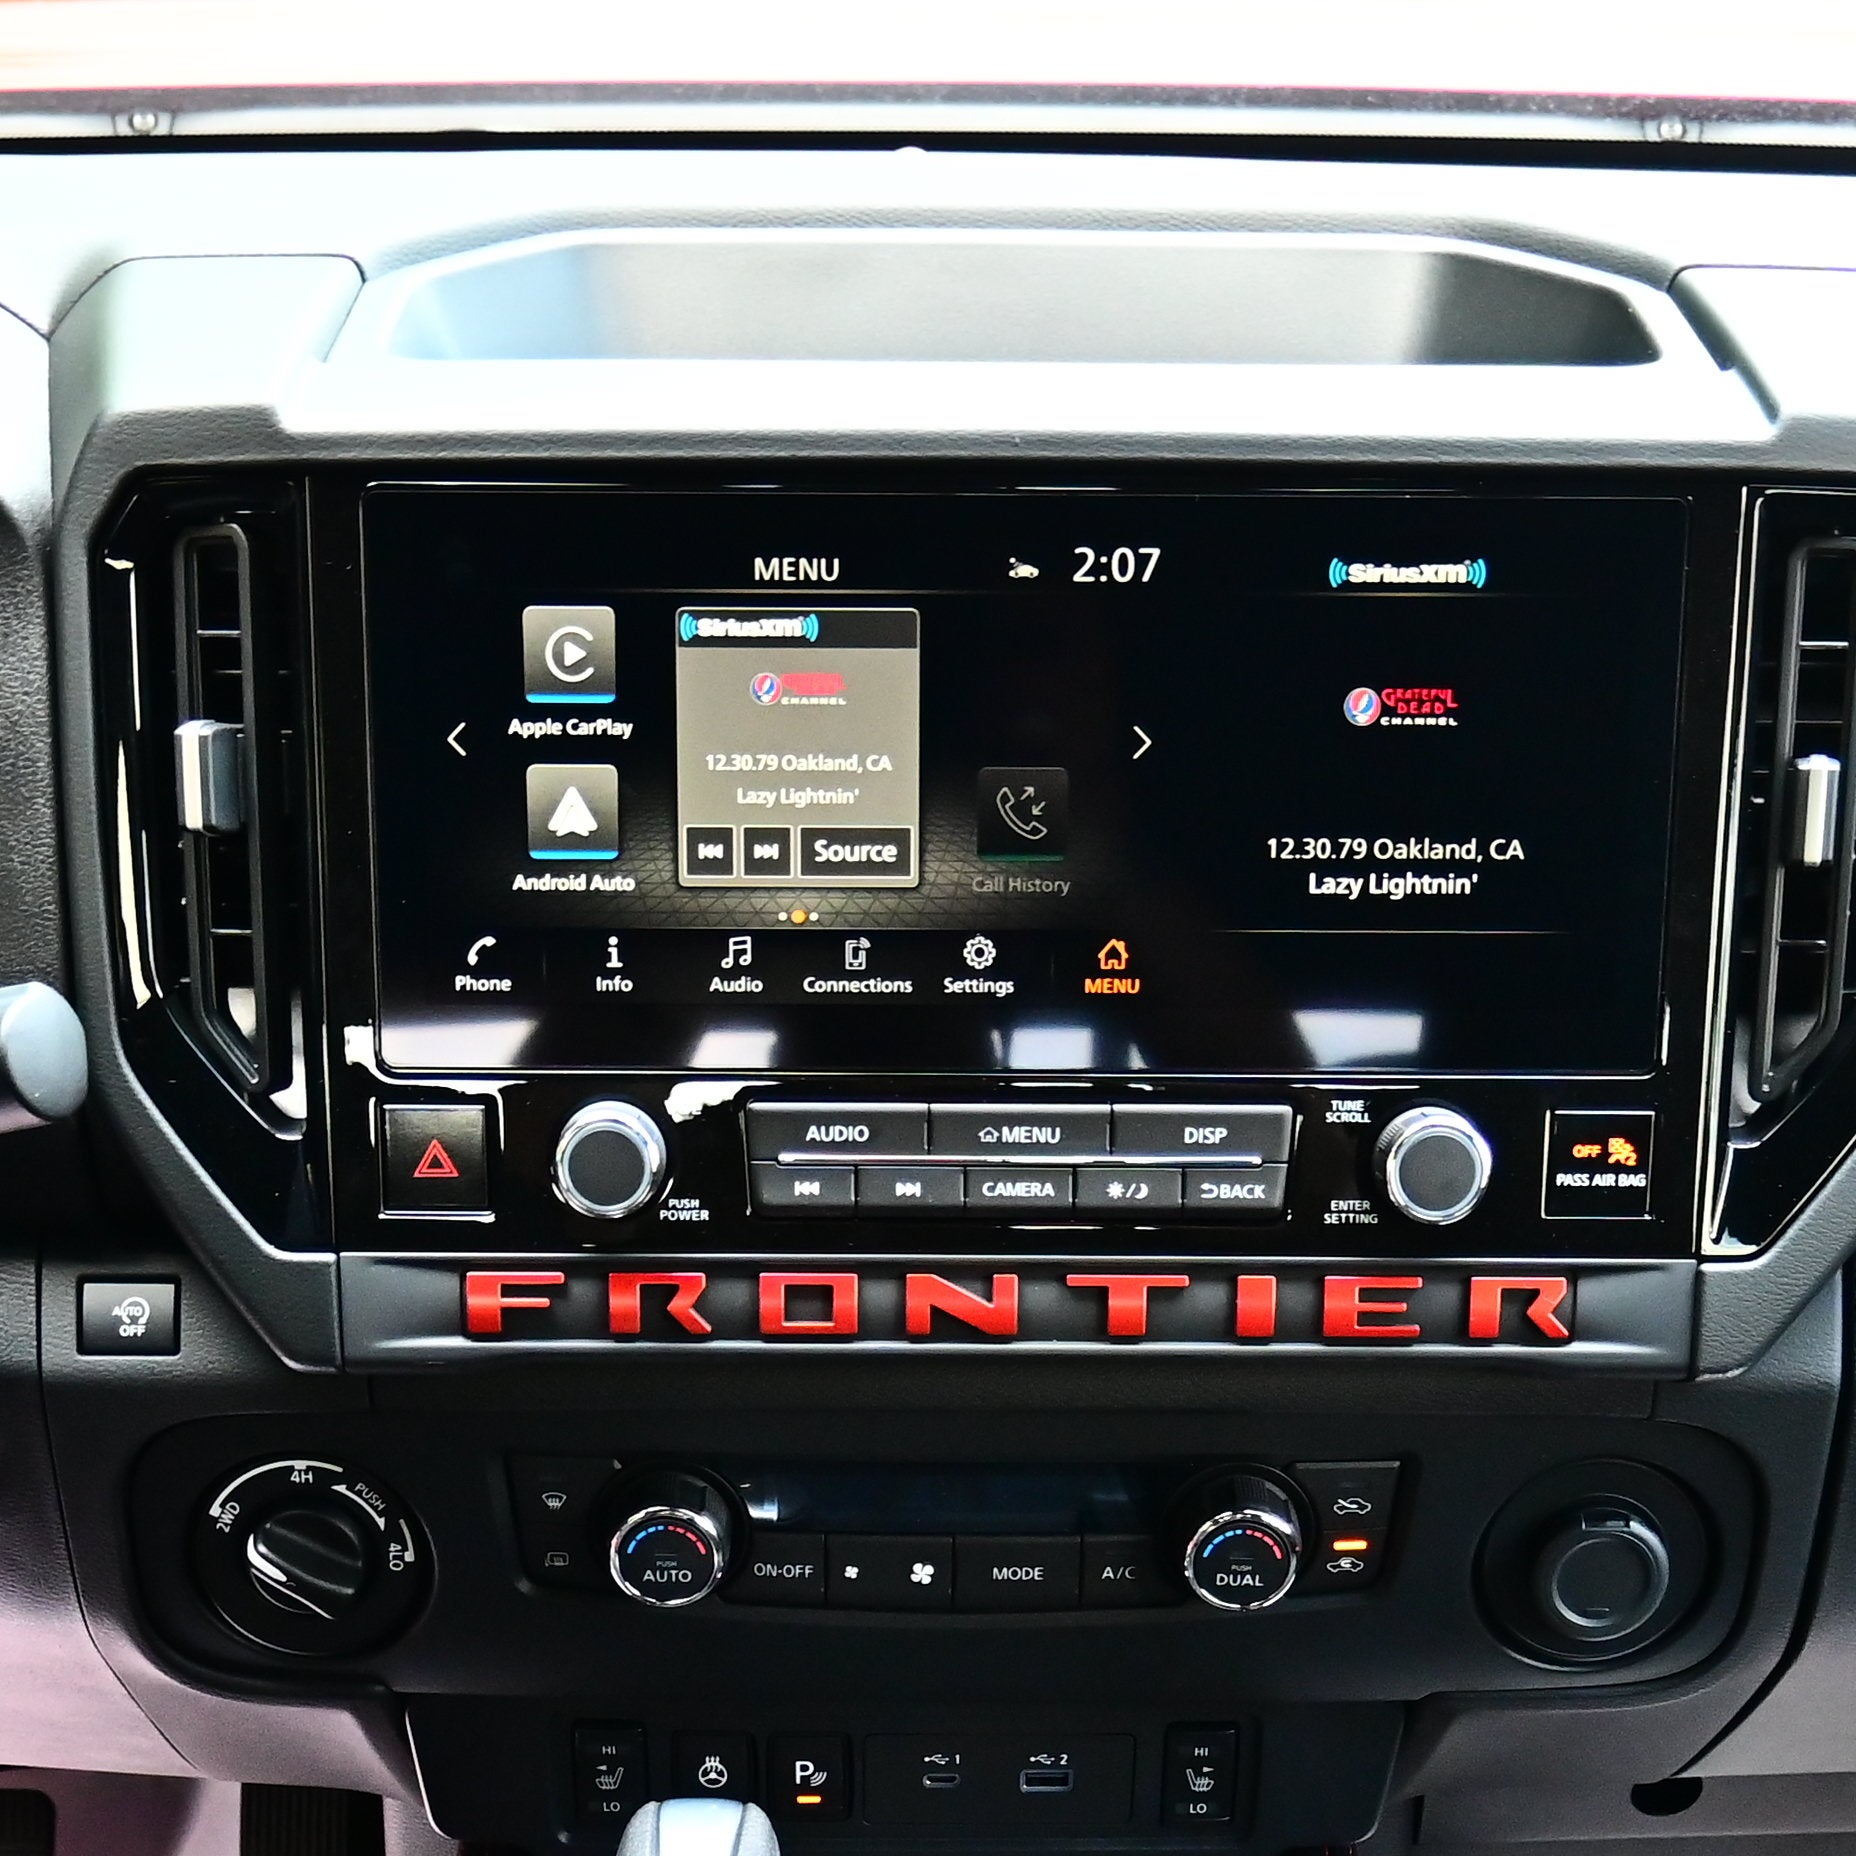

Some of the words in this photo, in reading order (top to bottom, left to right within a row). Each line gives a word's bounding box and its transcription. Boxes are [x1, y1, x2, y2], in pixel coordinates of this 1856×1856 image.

[754, 557, 840, 581] MENU
[1072, 546, 1161, 584] 2:07
[1348, 563, 1468, 583] SiriusXM
[696, 616, 803, 638] SiriusXM
[1397, 702, 1444, 714] DEAD
[508, 719, 562, 739] Apple
[566, 718, 633, 740] CarPlay
[1380, 717, 1459, 726] CHANNEL
[705, 754, 778, 772] 12.30.79
[781, 754, 862, 775] Oakland,
[866, 755, 892, 772] CA
[737, 788, 777, 809] Lazy
[780, 788, 860, 808] Lightnin'
[814, 839, 898, 863] Source
[1266, 838, 1367, 860] 12.30.79
[1373, 838, 1483, 864] Oakland,
[1489, 839, 1525, 860] CA
[513, 875, 586, 892] Android
[590, 875, 636, 892] Auto
[972, 876, 1003, 894] Call
[1007, 876, 1071, 898] History
[1309, 873, 1363, 900] Lazy
[1368, 873, 1478, 900] Lightnin'
[455, 974, 512, 994] Phone
[595, 974, 633, 994] Info
[709, 975, 763, 994] Audio
[803, 976, 913, 995] Connections
[943, 975, 1015, 998] Settings
[1084, 977, 1140, 994] MENU
[1331, 1100, 1365, 1112] TUNE
[1325, 1112, 1371, 1124] SCROLL
[806, 1125, 869, 1143] AUDIO
[1002, 1126, 1061, 1145] MENU
[1184, 1126, 1227, 1144] DISP
[1572, 1144, 1602, 1158] OFF
[1556, 1173, 1590, 1186] PASS
[1591, 1173, 1616, 1186] AIR
[1618, 1173, 1646, 1187] BAG
[982, 1181, 1055, 1198] CAMERA
[1220, 1182, 1266, 1200] BACK
[668, 1198, 700, 1209] PUSH
[1330, 1200, 1371, 1212] ENTER
[659, 1209, 709, 1221] POWER
[1323, 1213, 1378, 1225] SETTING
[464, 1270, 1571, 1340] FRONTIER
[119, 1324, 146, 1337] OFF
[290, 1470, 313, 1484] 4H
[354, 1482, 387, 1512] PUSH
[215, 1500, 241, 1534] 2WD
[388, 1542, 404, 1571] 4LO
[643, 1569, 692, 1584] AUTO
[992, 1566, 1044, 1582] MODE
[1101, 1565, 1136, 1580] A/C
[1216, 1573, 1264, 1588] DUAL
[601, 1745, 616, 1755] HI
[1194, 1747, 1208, 1756] HI
[602, 1802, 620, 1812] LO
[1189, 1803, 1207, 1813] LO
